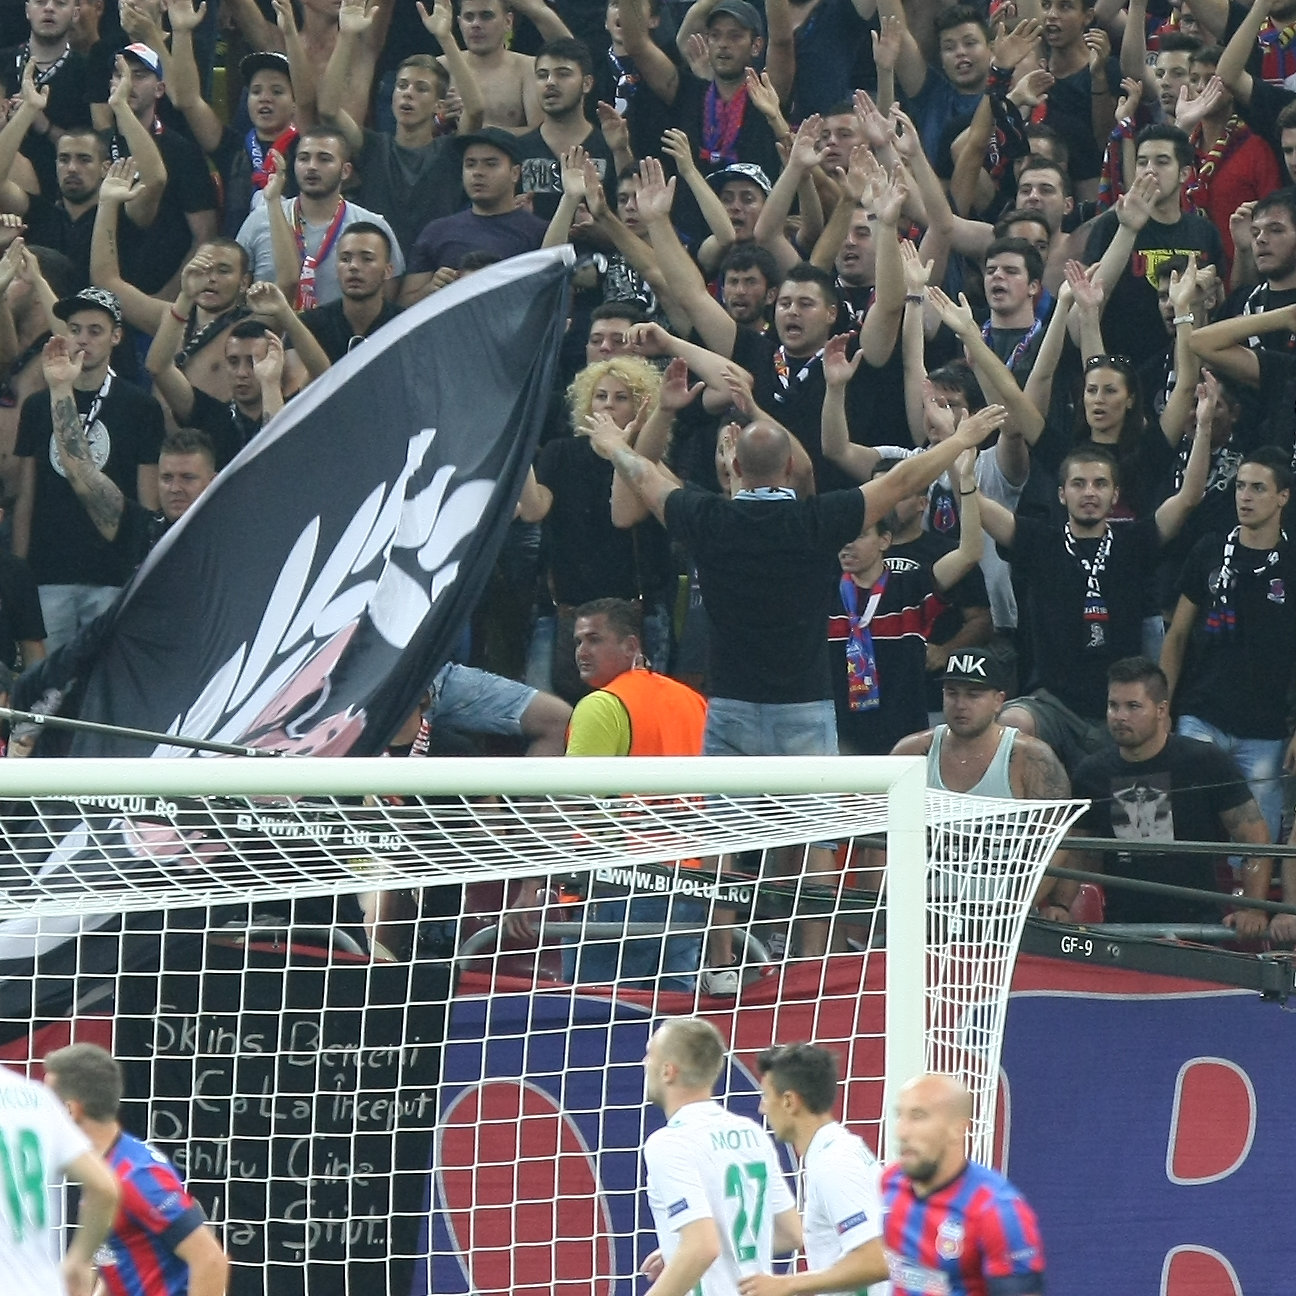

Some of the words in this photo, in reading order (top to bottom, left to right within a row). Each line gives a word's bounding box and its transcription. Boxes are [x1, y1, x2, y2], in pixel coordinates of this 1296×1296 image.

[946, 654, 988, 678] NK
[257, 815, 403, 852] WWW.BIVLUL.RO
[1061, 935, 1093, 957] GF-9
[145, 1006, 263, 1055] Skins
[710, 1129, 761, 1152] MOTI
[286, 1137, 374, 1187] Cine
[723, 1160, 767, 1262] 27
